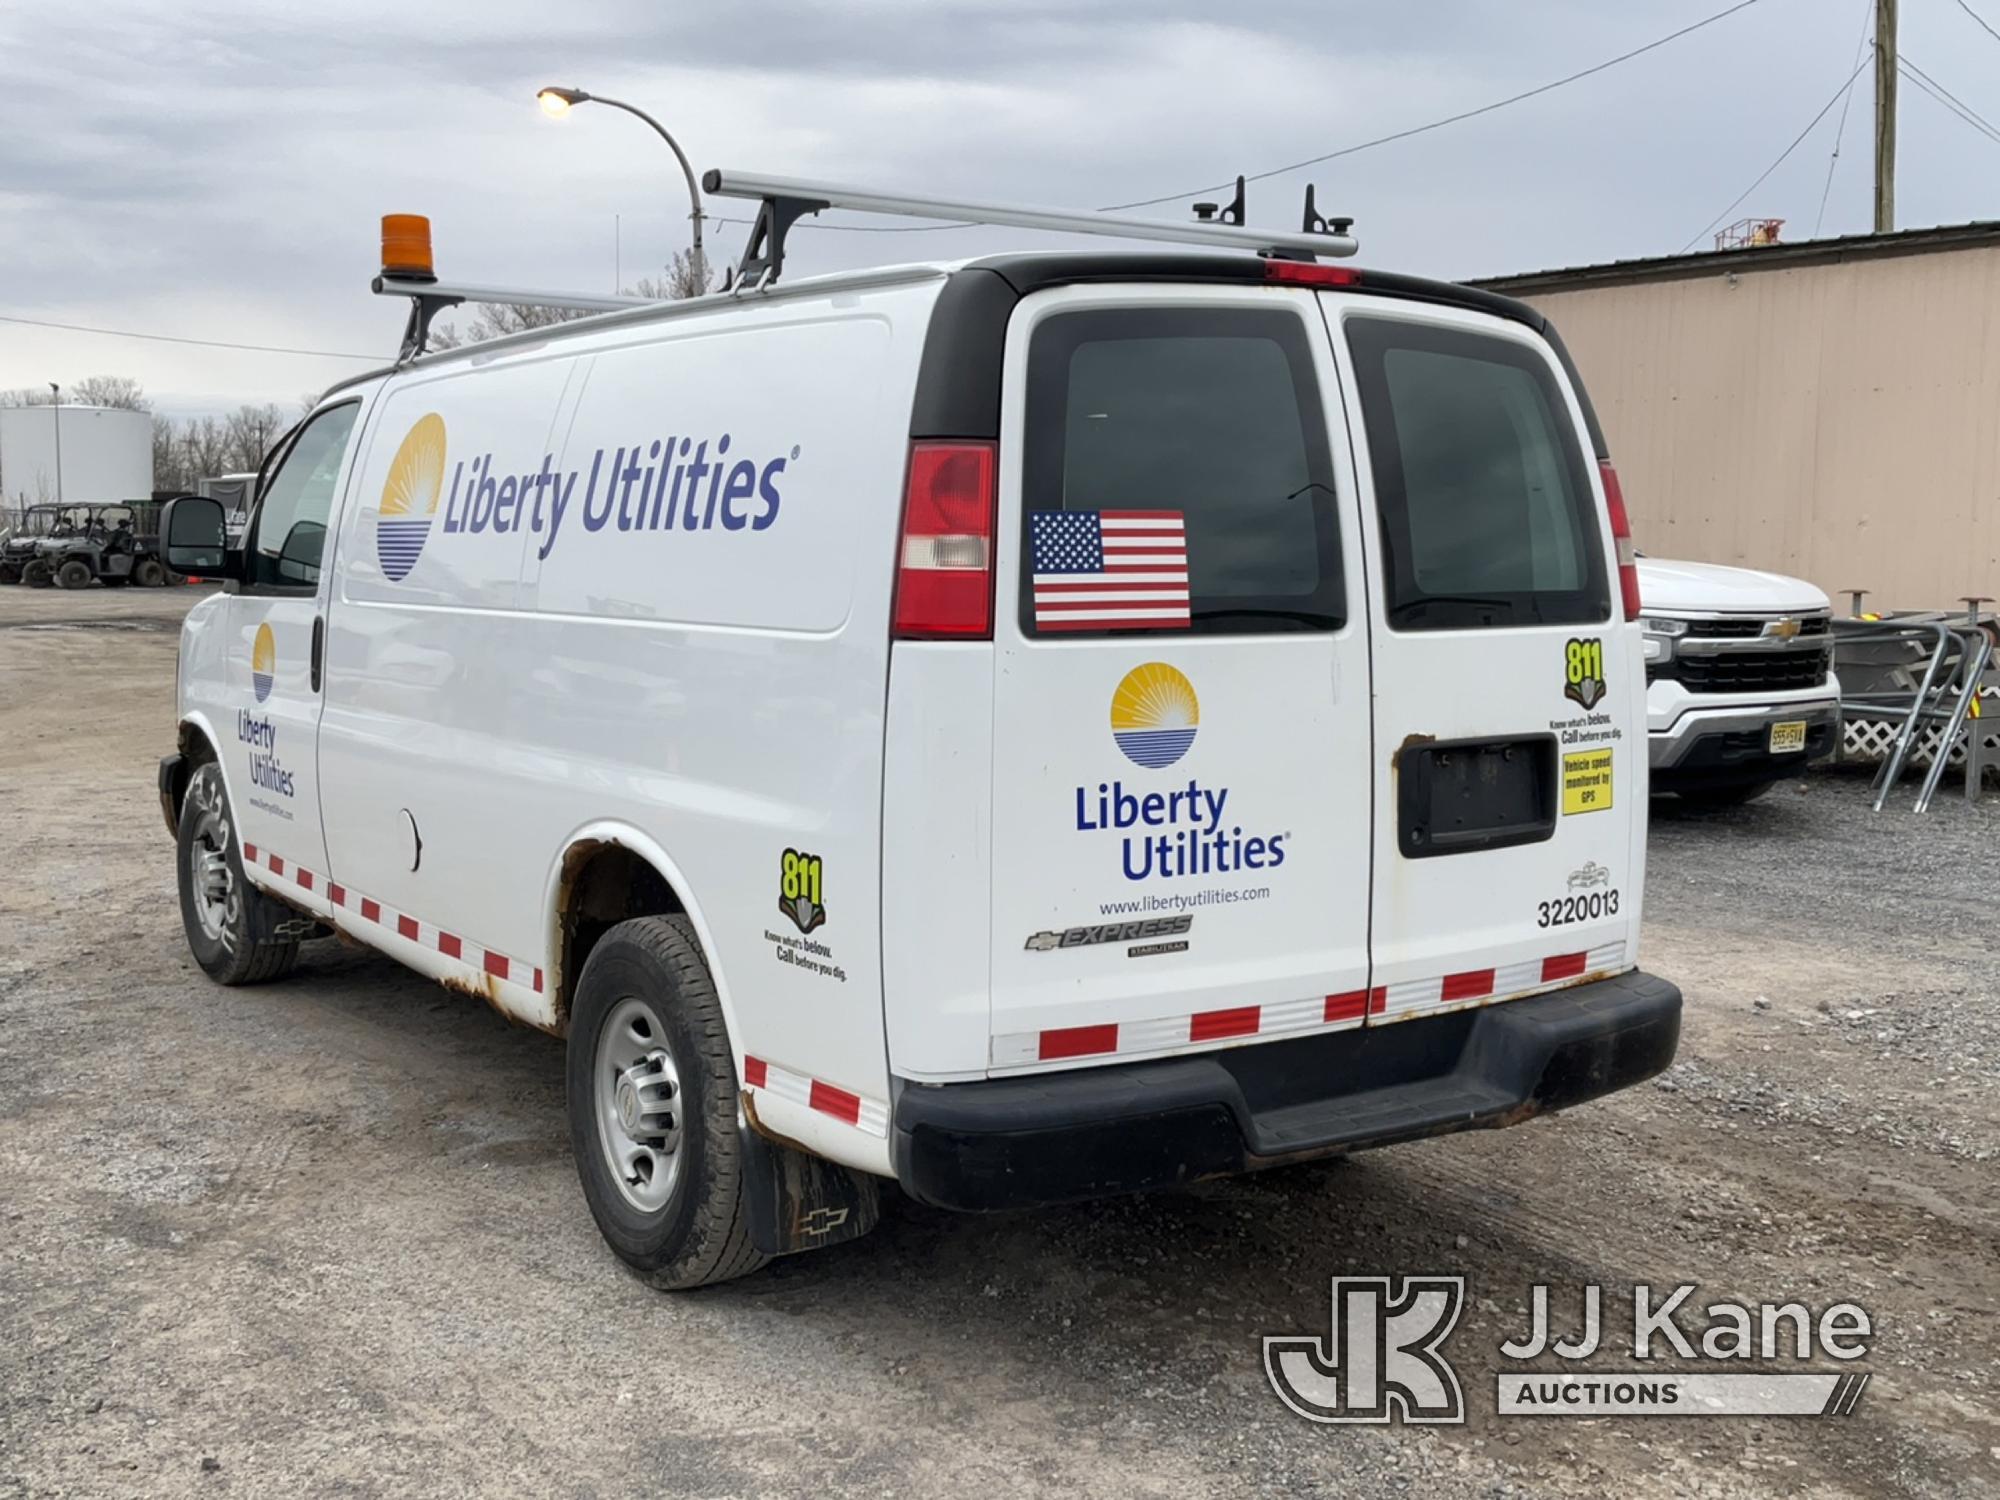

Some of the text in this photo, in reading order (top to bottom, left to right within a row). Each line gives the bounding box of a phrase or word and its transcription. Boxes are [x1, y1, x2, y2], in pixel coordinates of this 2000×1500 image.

[443, 452, 577, 560] Liberty
[1566, 638, 1603, 683] 811
[238, 708, 276, 759] Liberty
[1561, 729, 1579, 744] Call
[1564, 756, 1611, 772] Vehicle speed
[1602, 772, 1610, 785] by
[1076, 780, 1228, 835] Liberty
[1581, 789, 1596, 804] GPS
[781, 848, 821, 906] 811
[1100, 885, 1270, 915] www.libertyutilities.com
[1537, 888, 1619, 929] 3220013
[764, 929, 782, 944] Know
[782, 934, 803, 950] what's
[1061, 914, 1194, 948] EXPRESS
[776, 945, 794, 964] Call
[795, 954, 818, 972] before
[818, 963, 832, 976] you
